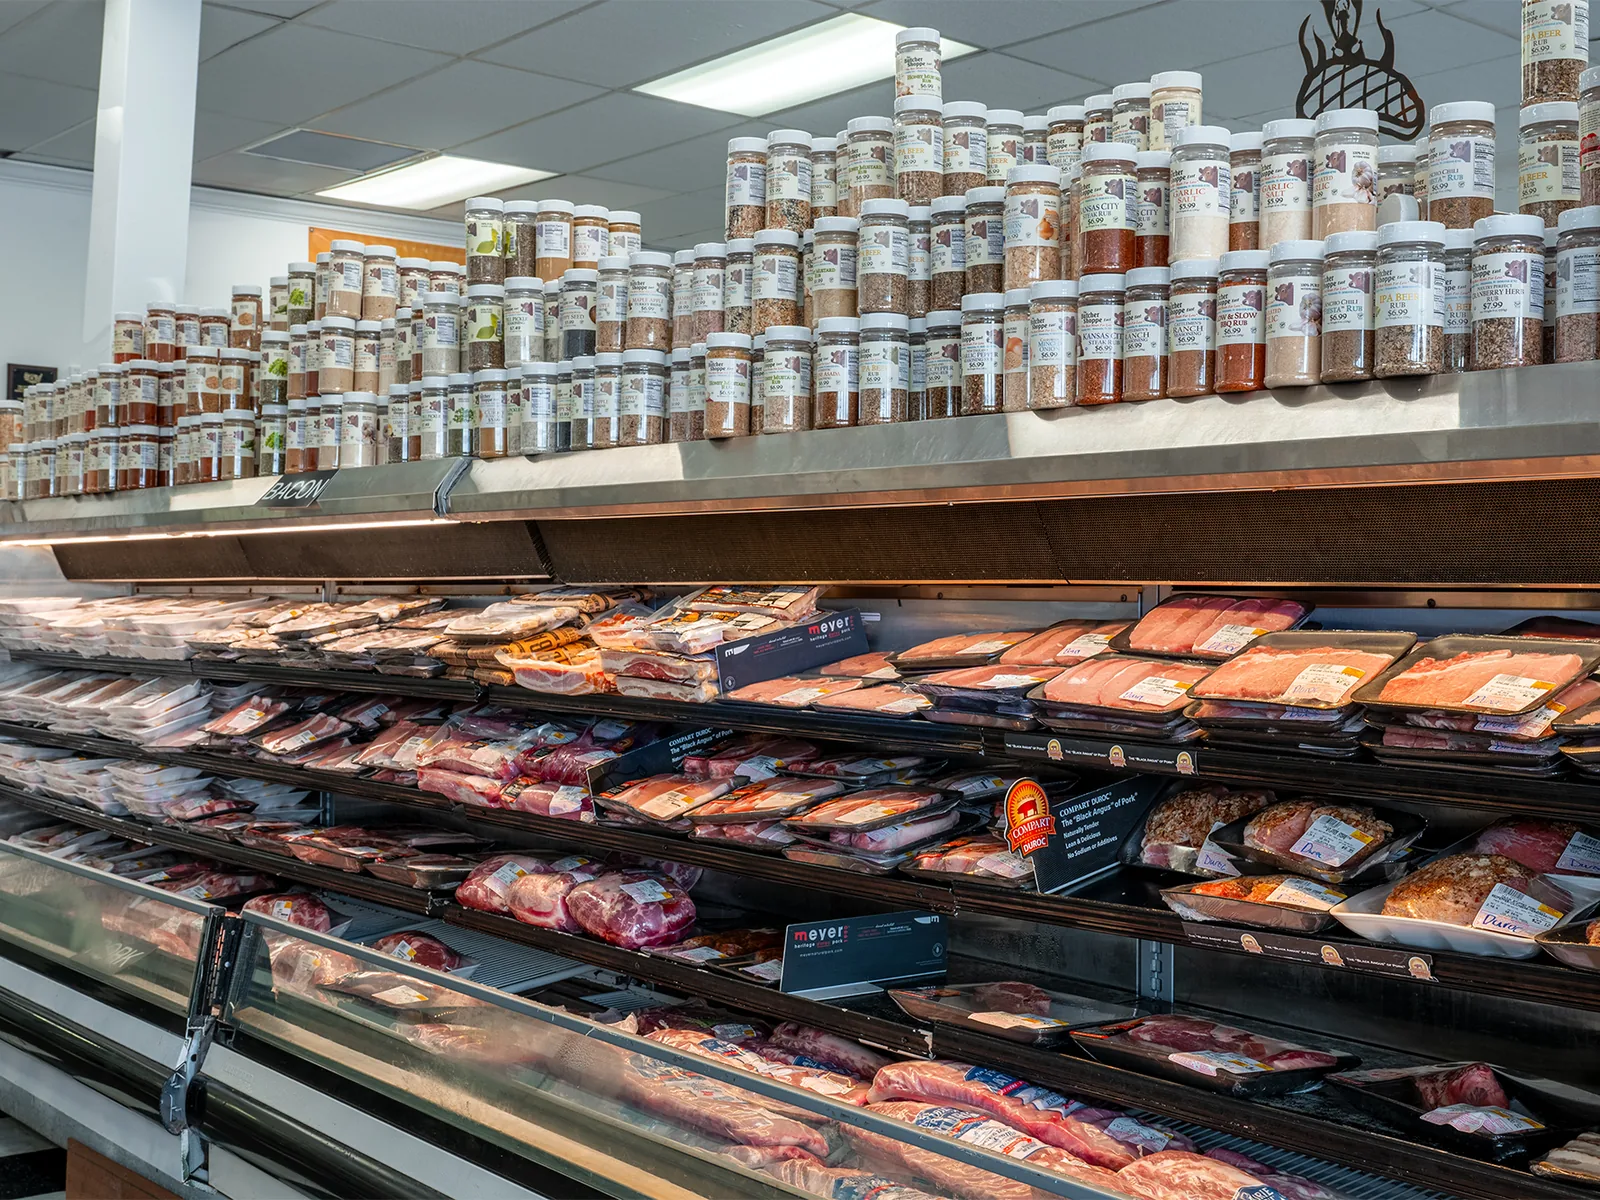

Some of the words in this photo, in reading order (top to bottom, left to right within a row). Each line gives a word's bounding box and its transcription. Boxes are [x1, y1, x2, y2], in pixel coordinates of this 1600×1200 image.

[1538, 30, 1561, 39] BEER
[1532, 38, 1547, 47] RUB
[1531, 45, 1550, 55] $6.99
[1447, 173, 1464, 181] RUB
[1527, 172, 1548, 181] BEER
[1262, 182, 1294, 191] GARLIC
[1431, 182, 1448, 191] $6.99
[1523, 181, 1535, 189] RUB
[1173, 188, 1205, 197] GARLIC
[1522, 187, 1537, 196] $6.99
[1177, 196, 1198, 204] SALT
[1505, 288, 1525, 296] HERB
[1379, 295, 1393, 304] IPA
[1395, 292, 1419, 301] BEER
[1483, 302, 1503, 310] $7.99
[1081, 312, 1099, 320] Butcher
[1235, 311, 1257, 319] SLOW
[1329, 313, 1347, 321] $6.99
[1388, 309, 1408, 318] $6.99
[1447, 319, 1468, 327] $6.99
[1224, 327, 1241, 335] $6.99
[1110, 332, 1124, 340] CIT
[262, 478, 329, 500] BACON
[808, 616, 850, 635] meyer
[810, 634, 828, 642] heritage
[669, 734, 694, 746] COMPART
[695, 728, 711, 737] DUROC
[680, 741, 696, 750] "Black
[696, 734, 715, 746] Angus"
[721, 729, 733, 737] Pork
[1060, 800, 1090, 817] COMPART
[1091, 793, 1110, 805] DUROC
[1061, 819, 1073, 827] The
[1073, 810, 1092, 822] "Black
[1092, 802, 1114, 816] Angus"
[1114, 799, 1121, 808] of
[1121, 794, 1136, 805] Pork
[1013, 817, 1050, 838] COMPART
[1063, 826, 1084, 839] Naturally
[1084, 821, 1099, 831] Tender
[1023, 837, 1046, 852] DUROC
[1065, 841, 1076, 849] Lean
[1080, 832, 1101, 843] Delicious
[1074, 846, 1091, 856] Sodium
[1097, 836, 1118, 847] Additives
[1204, 854, 1226, 870] Duroc
[1482, 914, 1523, 932] Duroc
[794, 925, 843, 941] meyer
